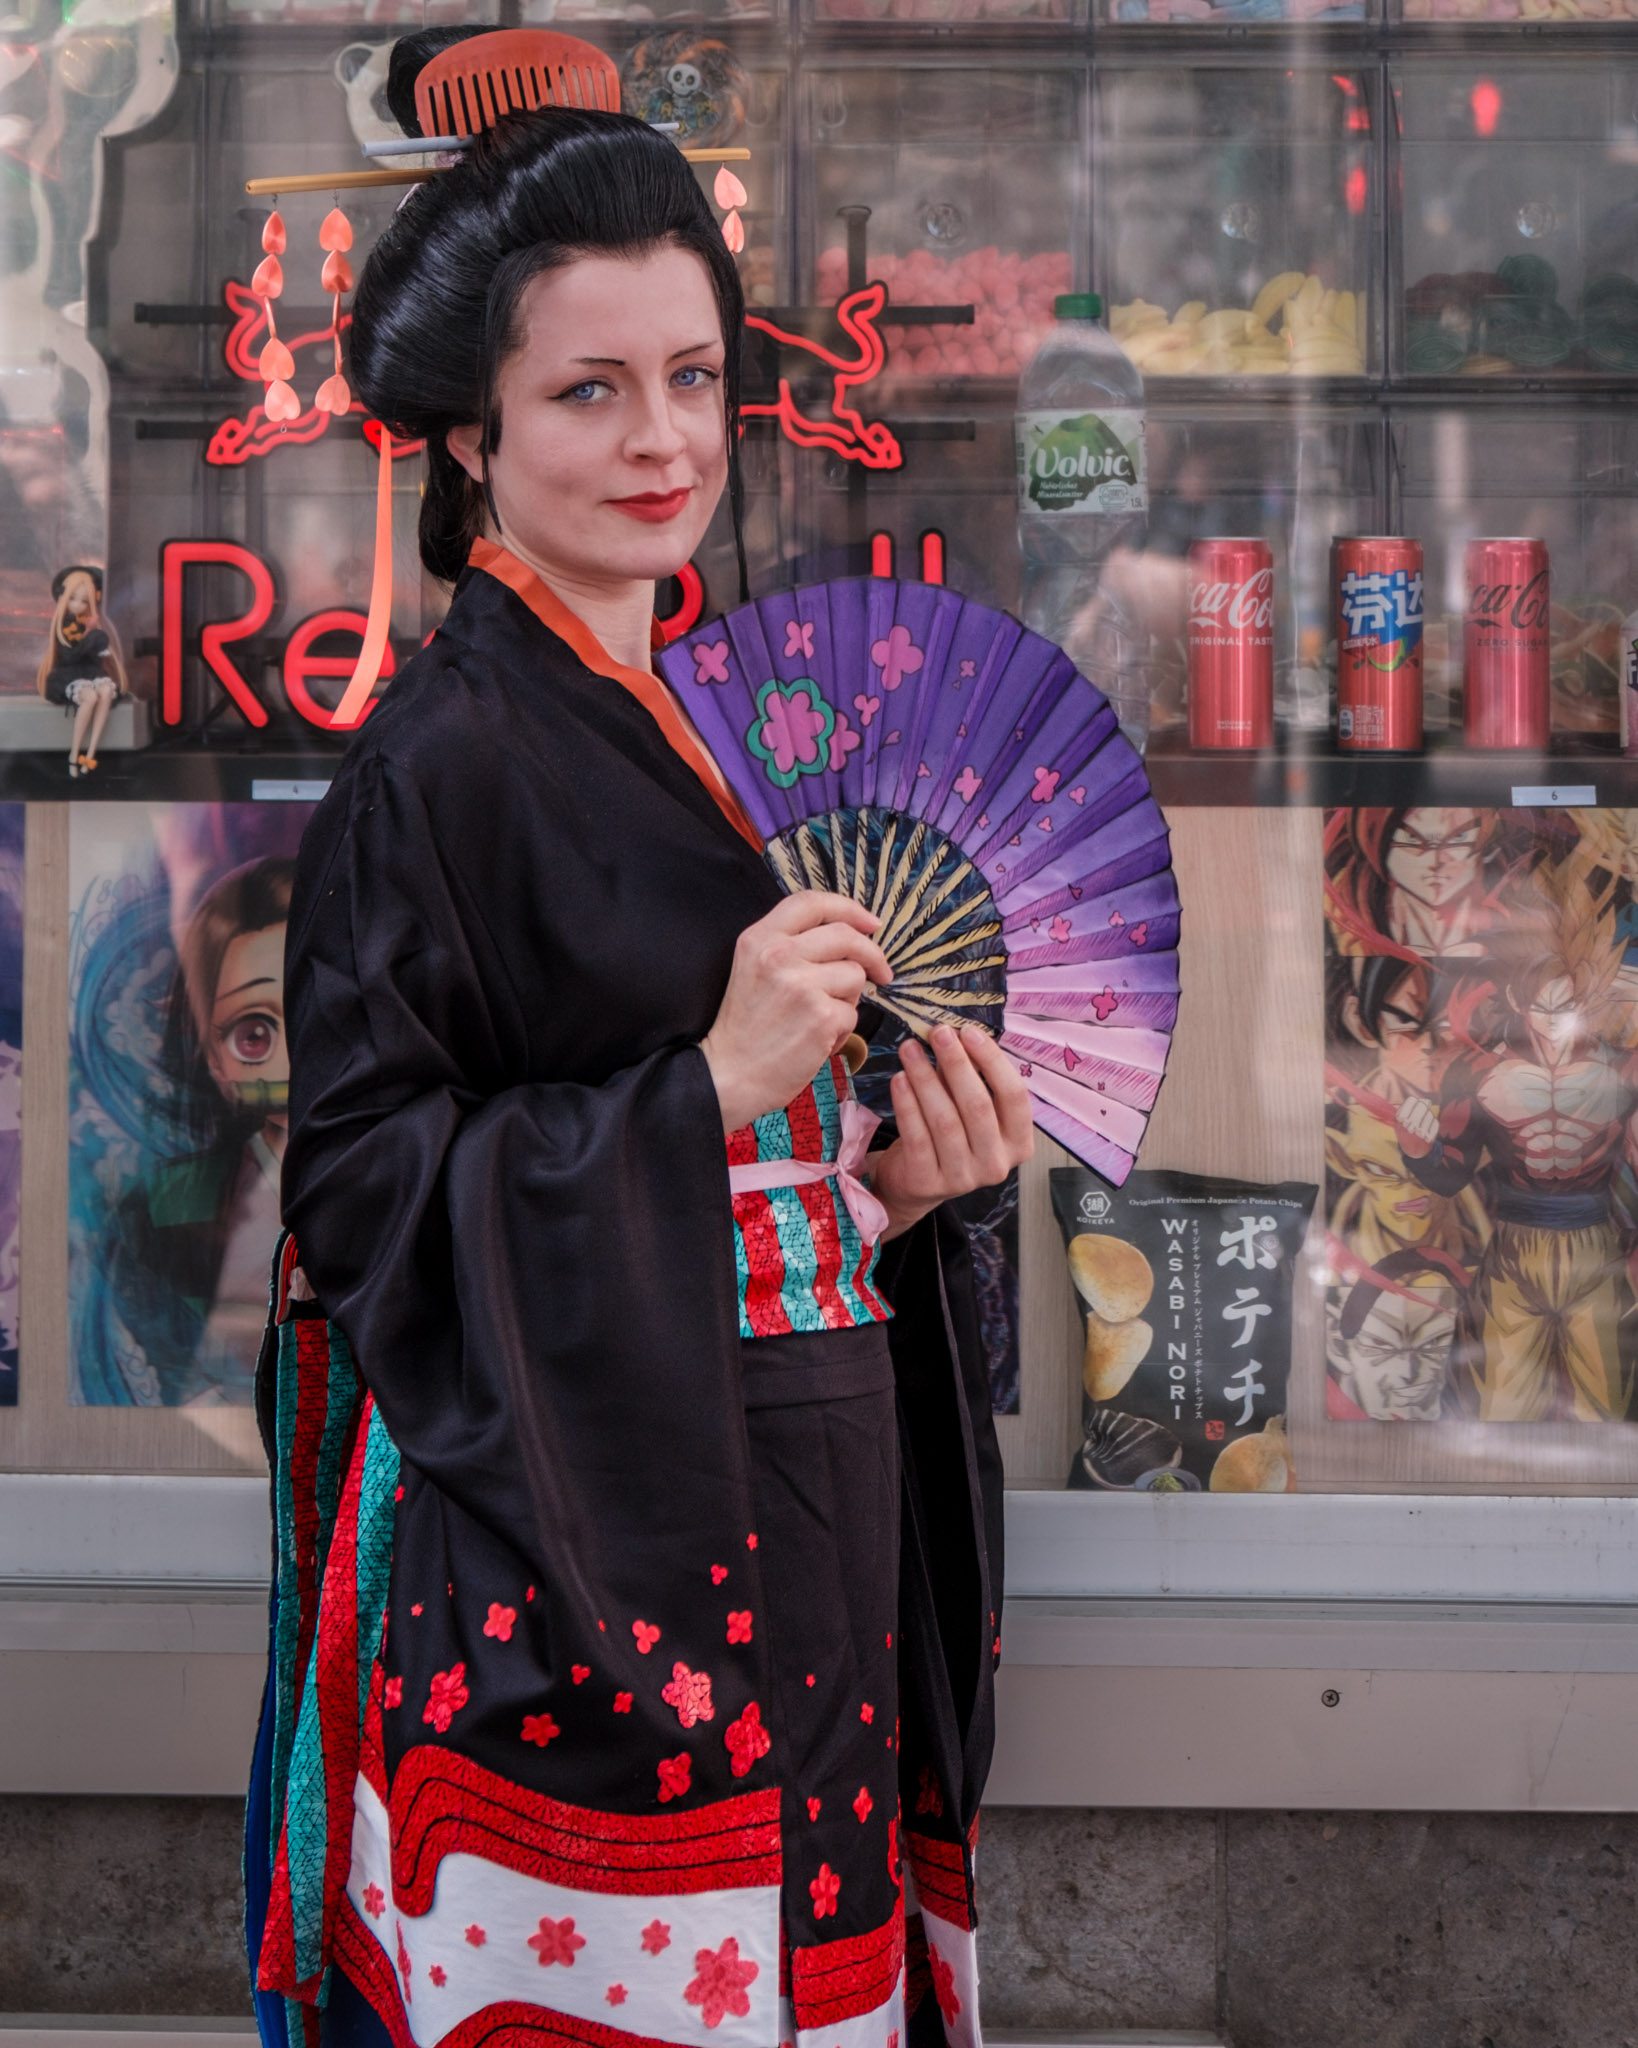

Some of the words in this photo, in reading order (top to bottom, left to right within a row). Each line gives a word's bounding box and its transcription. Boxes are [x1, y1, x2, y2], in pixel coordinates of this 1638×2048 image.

[1037, 446, 1130, 479] Volvic
[163, 541, 442, 731] Re
[1551, 790, 1558, 801] 6
[1076, 1215, 1115, 1225] KOIKEYA
[1128, 1197, 1164, 1207] Original
[1166, 1196, 1206, 1205] Premium
[1248, 1197, 1277, 1206] Potato
[1279, 1199, 1303, 1208] Chips
[1160, 1218, 1188, 1330] WASABI
[1216, 1215, 1277, 1426] ポテチ
[1167, 1342, 1187, 1420] NORI
